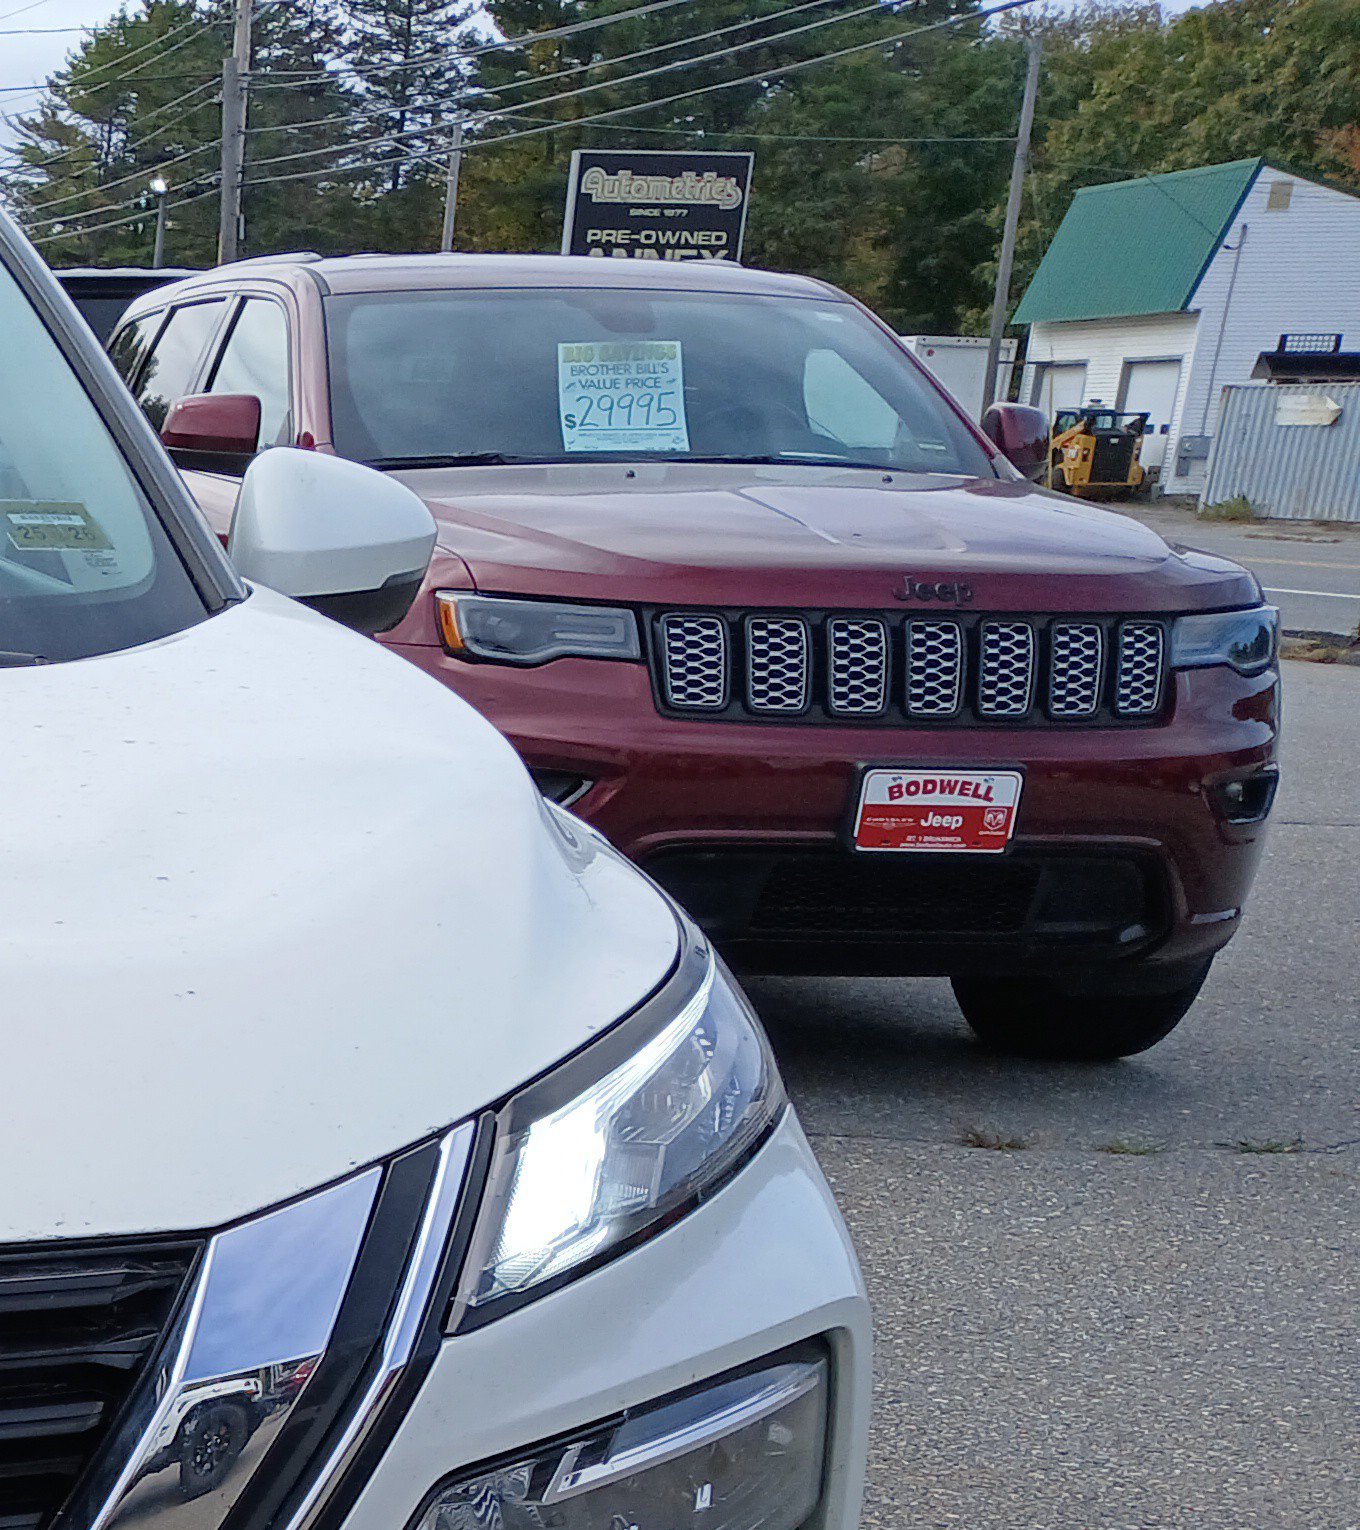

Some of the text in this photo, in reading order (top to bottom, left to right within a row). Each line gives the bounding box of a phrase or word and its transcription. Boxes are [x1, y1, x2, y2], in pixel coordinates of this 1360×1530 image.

[586, 229, 728, 245] PRE-OWNED
[570, 363, 632, 376] BROTHER
[578, 378, 620, 390] VALUE
[625, 377, 662, 389] PRICE
[892, 575, 973, 607] Jeep
[887, 778, 995, 803] BODWELL
[920, 811, 964, 830] Jeep
